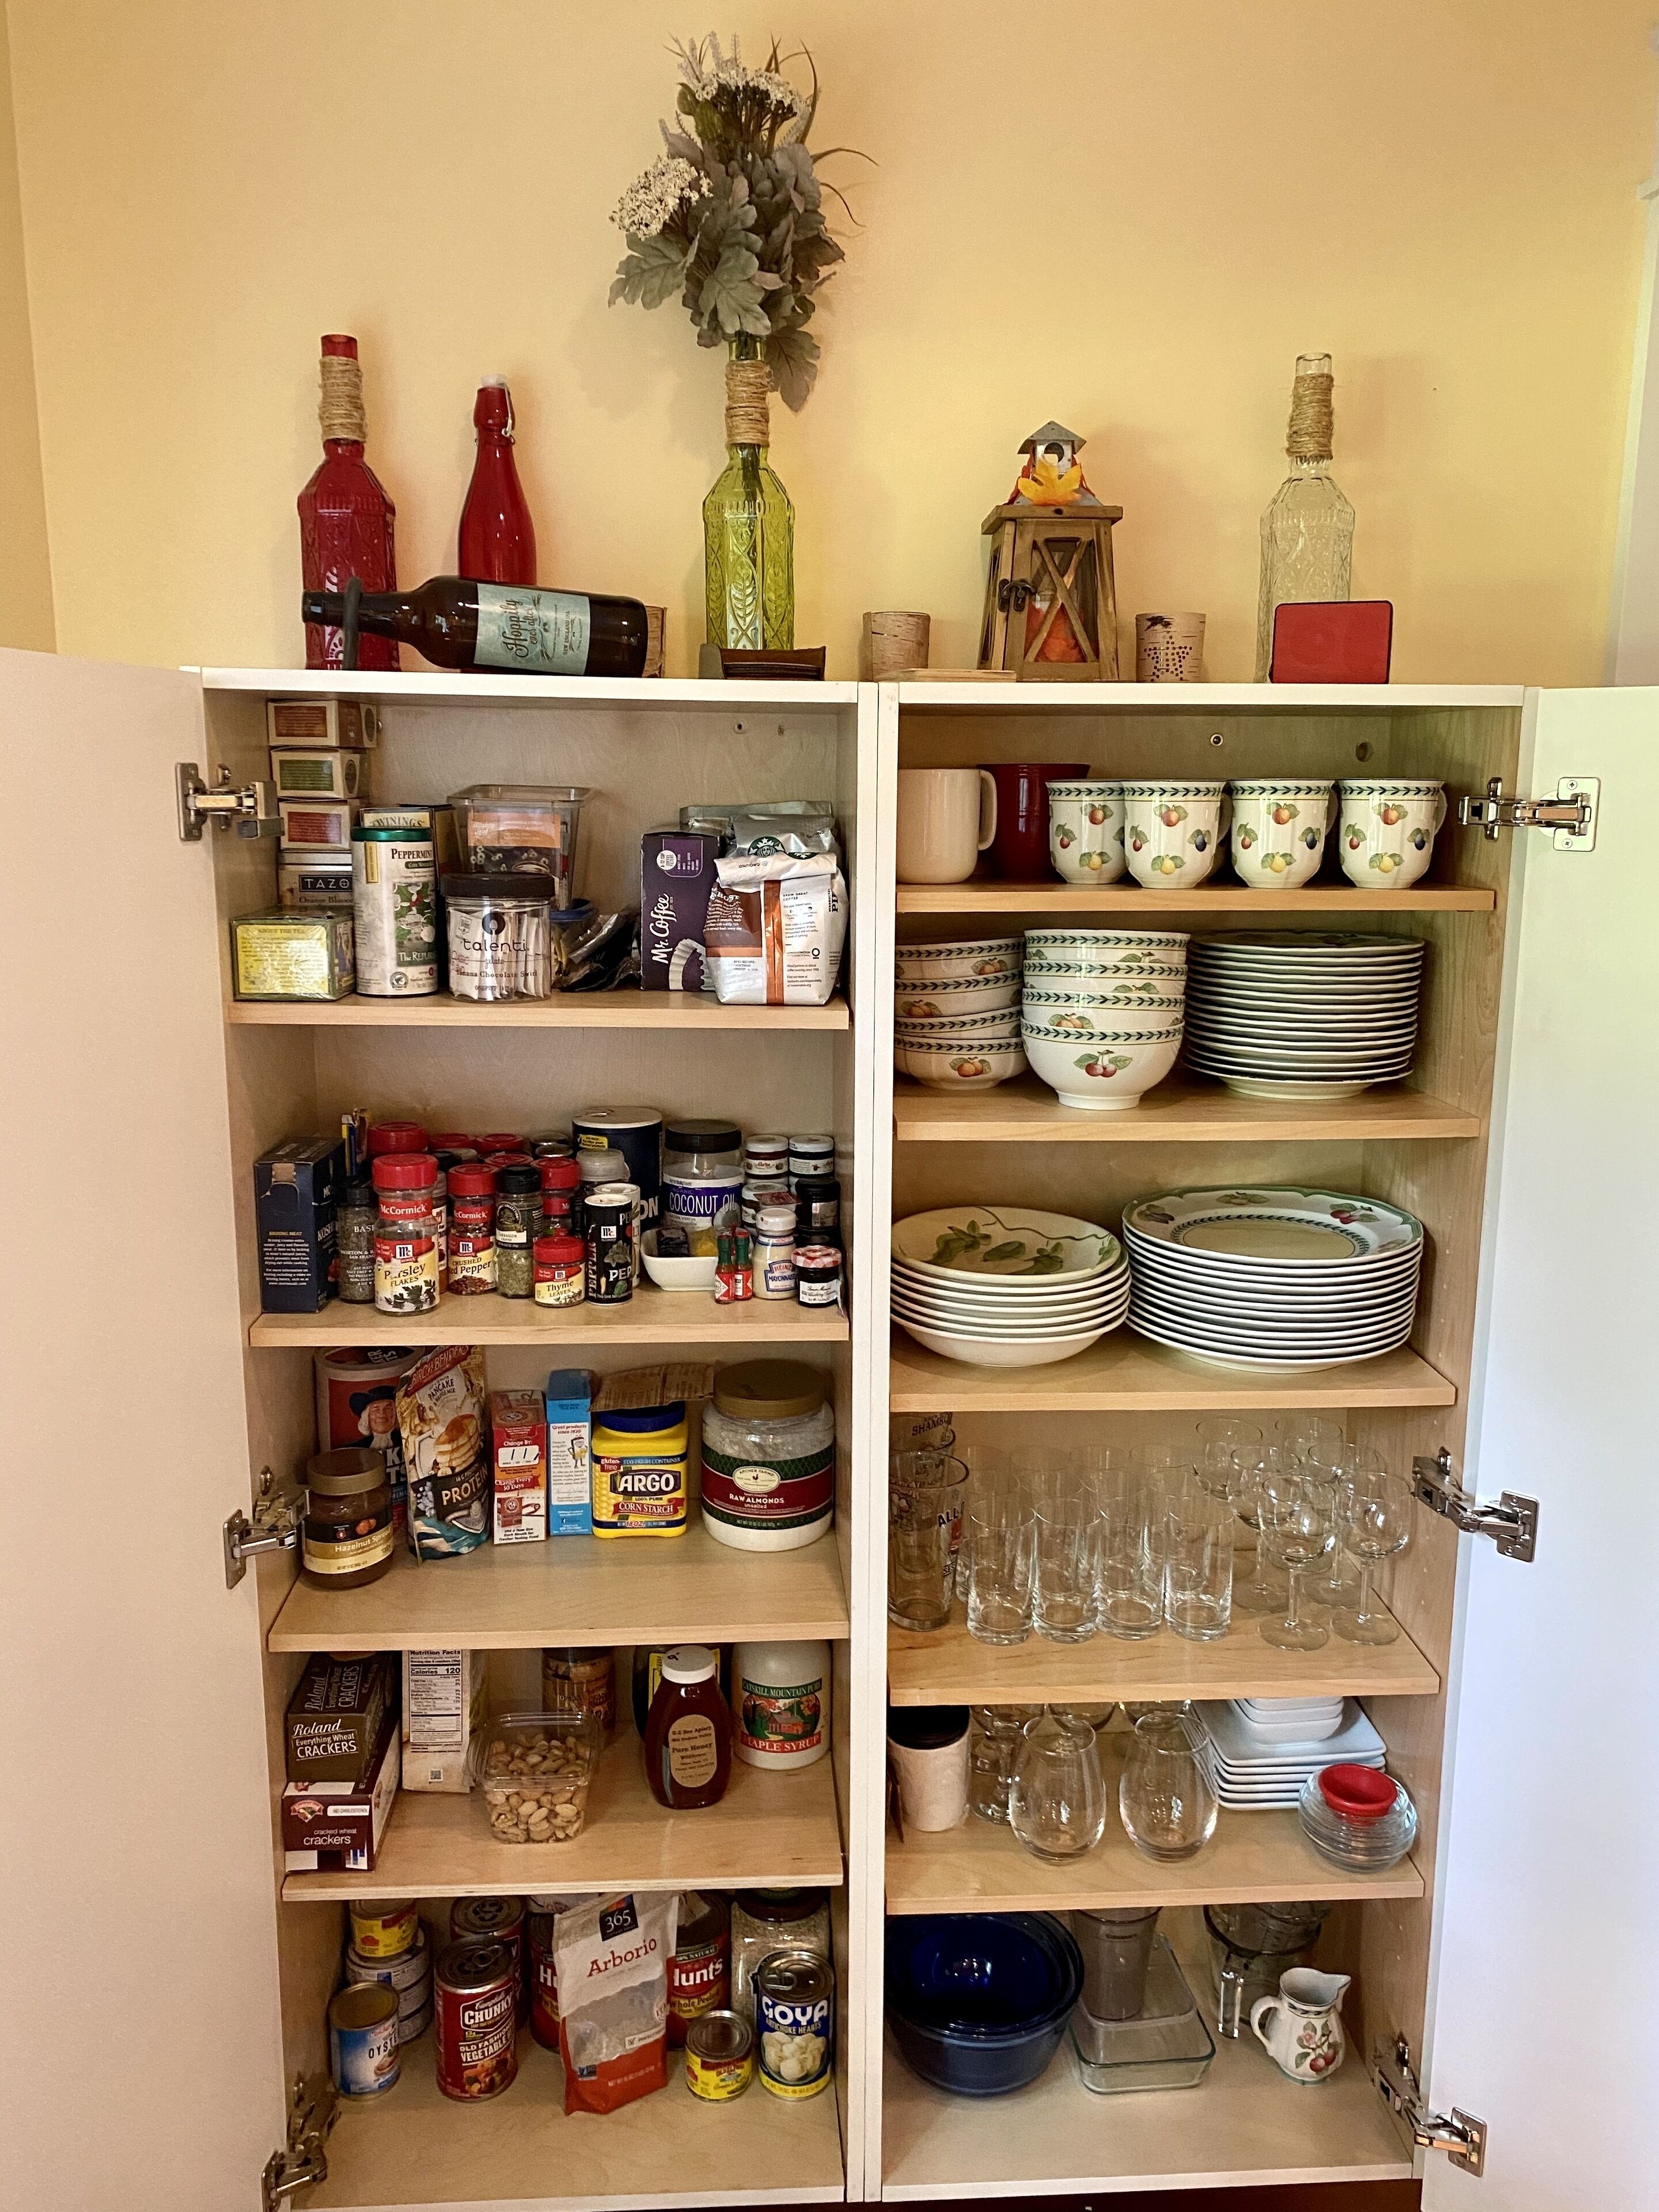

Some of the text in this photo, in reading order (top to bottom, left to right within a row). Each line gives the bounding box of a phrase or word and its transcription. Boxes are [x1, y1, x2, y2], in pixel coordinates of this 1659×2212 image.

[499, 599, 529, 657] Hoppily
[304, 879, 349, 888] TAZO
[299, 896, 326, 904] Orange
[649, 893, 677, 964] Mr. Coffee
[463, 940, 527, 952] talenti
[399, 952, 411, 961] The
[380, 1204, 427, 1215] McCormick
[670, 1192, 736, 1214] COCONUT OIL
[454, 1211, 487, 1219] cCormick
[452, 1257, 482, 1266] CRUSHED
[461, 1260, 491, 1275] Pepper
[774, 1264, 791, 1272] HEINZ
[385, 1263, 426, 1279] Prsley
[391, 1276, 419, 1286] FLAKES
[547, 1280, 574, 1292] Thyme
[550, 1289, 571, 1297] LEAVES
[407, 1362, 433, 1390] BIRCH
[428, 1378, 454, 1399] PANCAKE
[441, 1463, 488, 1505] PROTEIN
[618, 1474, 675, 1492] ARGO
[729, 1493, 745, 1502] RAW
[619, 1502, 673, 1514] CORN STARCH
[335, 1526, 391, 1552] Hazelnut Spread
[304, 1676, 327, 1711] Roland
[338, 1665, 359, 1707] CRACKERS
[743, 1681, 770, 1696] CATSKILL
[770, 1687, 806, 1697] MOUNTAIN
[293, 1718, 342, 1736] Roland
[296, 1733, 355, 1746] Everything Wheat
[784, 1734, 820, 1751] SYRUP
[297, 1740, 357, 1758] CRACKERS
[303, 1835, 351, 1845] crackers
[605, 1910, 631, 1933] 365
[587, 1938, 657, 1977] Arborio
[690, 1947, 715, 1959] NATURAL
[464, 1992, 512, 2025] CHUNKY
[762, 1995, 828, 2025] GOYA
[798, 2021, 821, 2035] HEARTS
[461, 2035, 507, 2062] VEGETABLE
